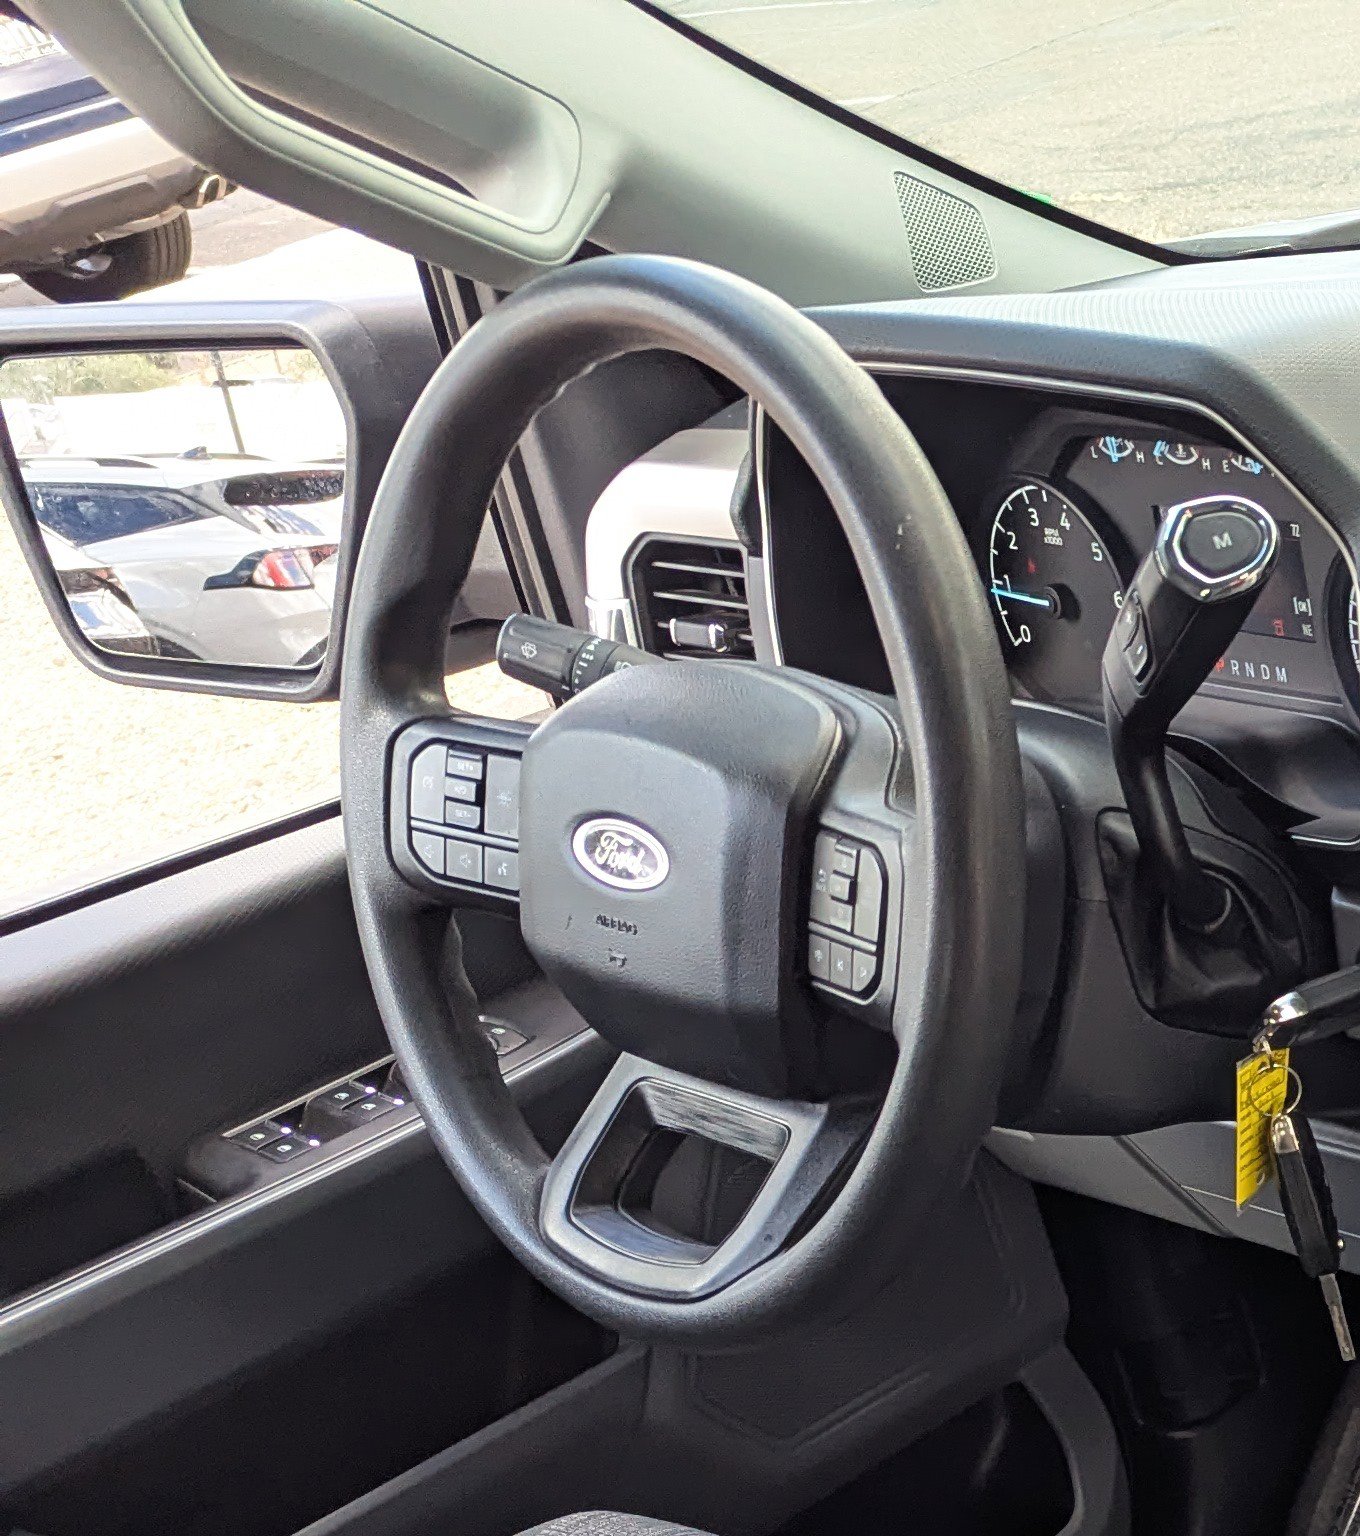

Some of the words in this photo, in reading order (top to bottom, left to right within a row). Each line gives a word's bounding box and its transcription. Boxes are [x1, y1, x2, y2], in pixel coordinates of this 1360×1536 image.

[1201, 458, 1211, 471] H
[1222, 460, 1231, 473] E
[1027, 507, 1040, 527] 3
[1060, 511, 1071, 531] 4
[1006, 531, 1019, 551] 2
[1211, 530, 1233, 550] M
[1090, 541, 1103, 562] 5
[1113, 590, 1124, 609] 6
[1019, 624, 1032, 643] 0
[595, 831, 650, 878] Ford
